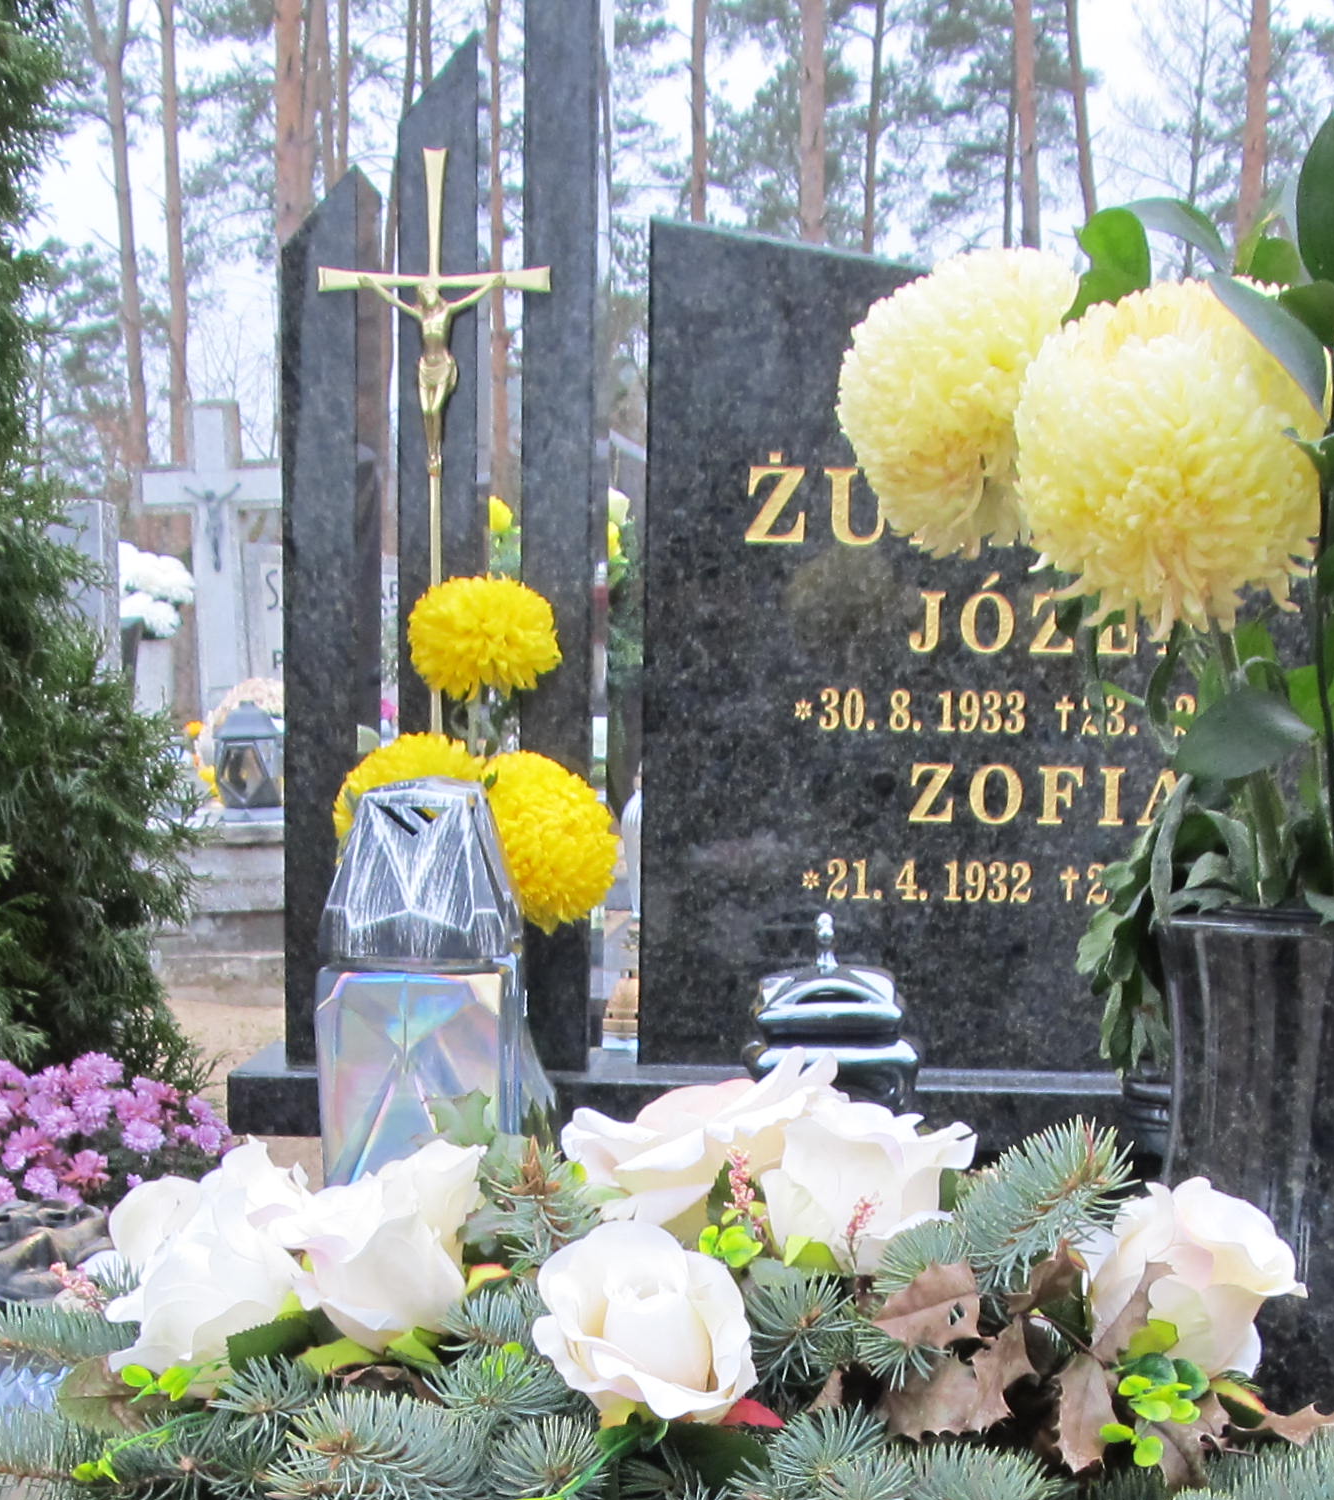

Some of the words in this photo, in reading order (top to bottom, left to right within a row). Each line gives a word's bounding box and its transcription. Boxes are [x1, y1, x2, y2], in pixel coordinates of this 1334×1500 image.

[908, 571, 1169, 655] JÓZ
[888, 687, 923, 733] 8.
[937, 689, 1027, 734] 1933
[907, 762, 1181, 827] ZOFIA
[895, 858, 929, 902] 4.
[943, 860, 1034, 903] 1932
